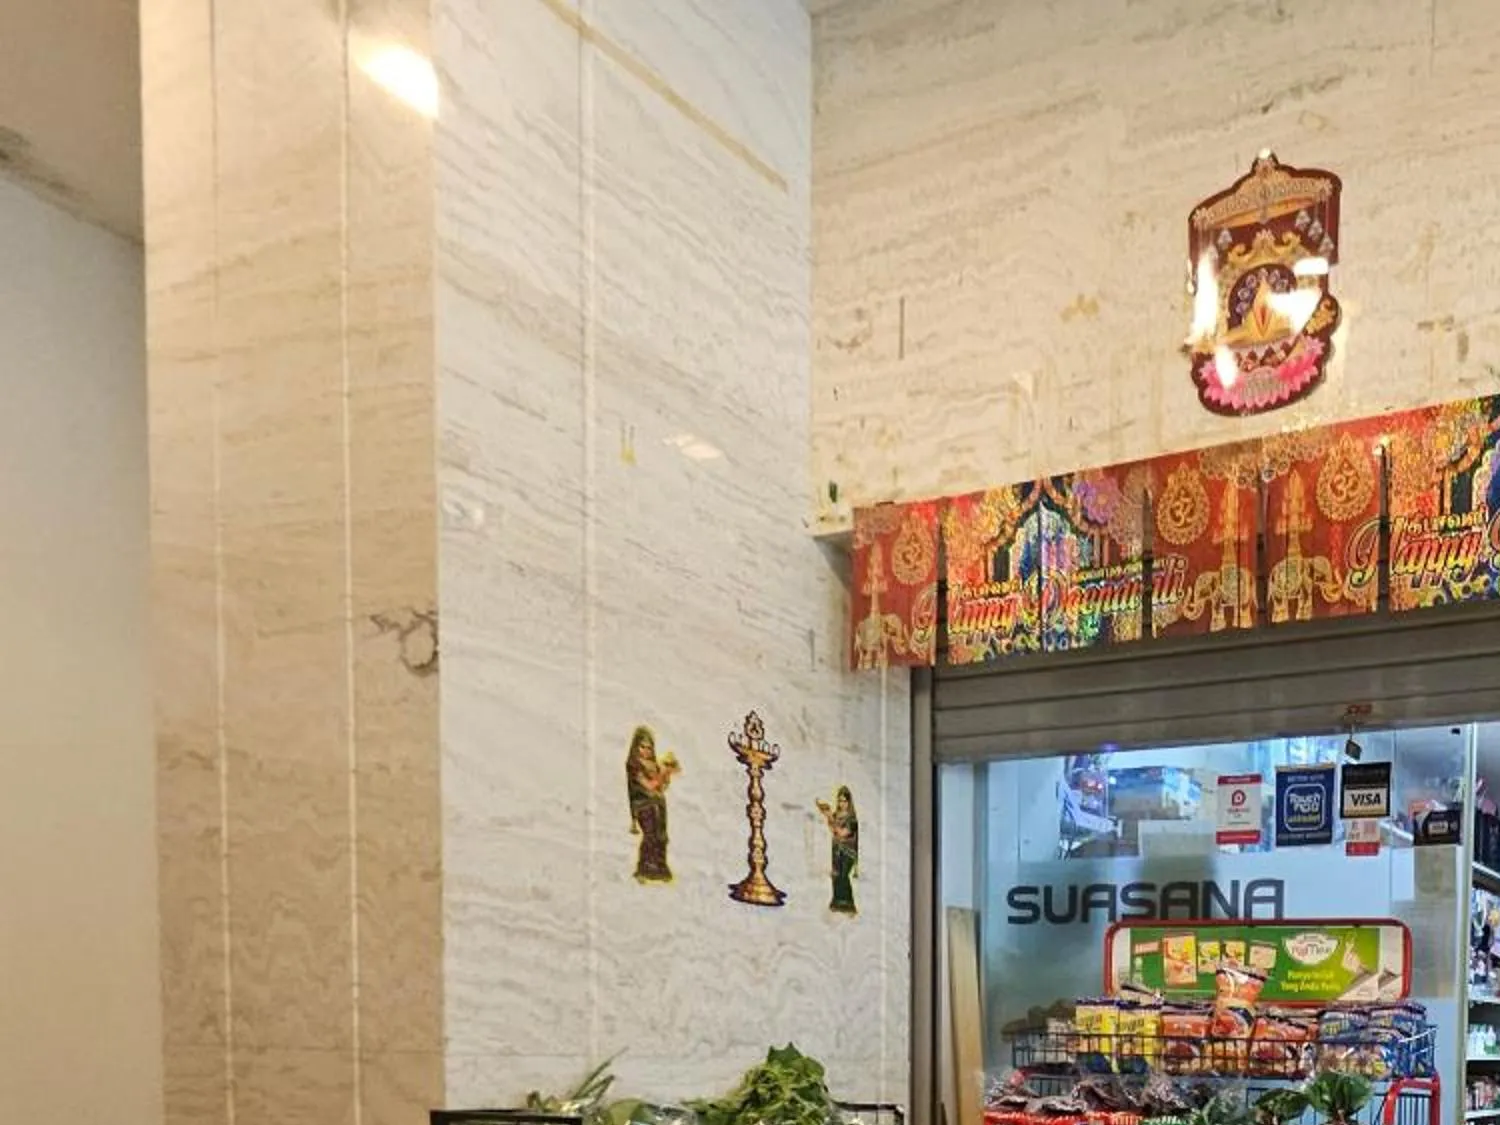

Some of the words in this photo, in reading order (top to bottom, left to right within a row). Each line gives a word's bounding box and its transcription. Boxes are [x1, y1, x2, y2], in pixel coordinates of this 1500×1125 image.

[1346, 514, 1485, 588] Happy
[1350, 793, 1382, 807] VISA
[1007, 878, 1285, 925] SUASANA
